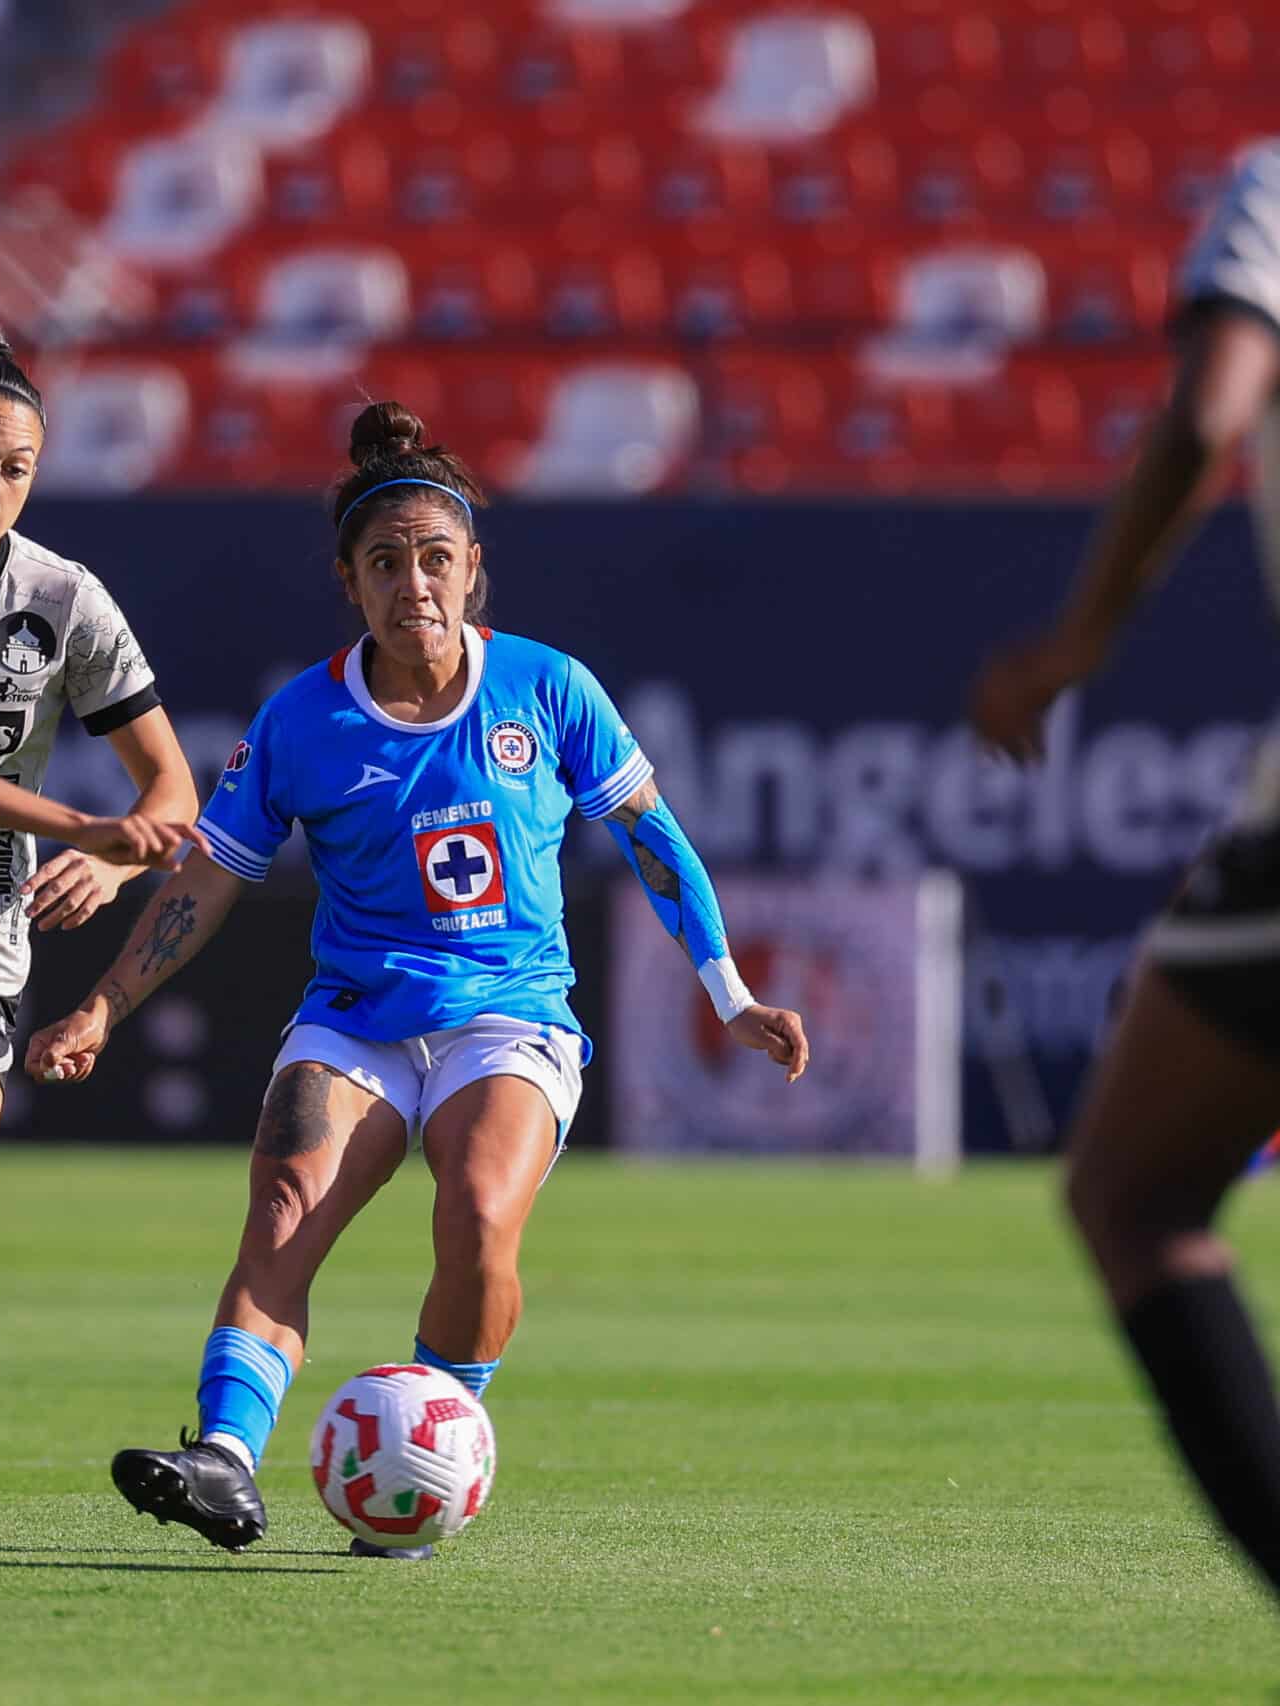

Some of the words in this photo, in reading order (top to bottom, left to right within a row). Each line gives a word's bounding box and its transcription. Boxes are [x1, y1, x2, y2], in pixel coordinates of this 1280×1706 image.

[411, 800, 493, 829] CEMENTO
[432, 913, 470, 932] CRUZ
[471, 909, 505, 927] AZUL
